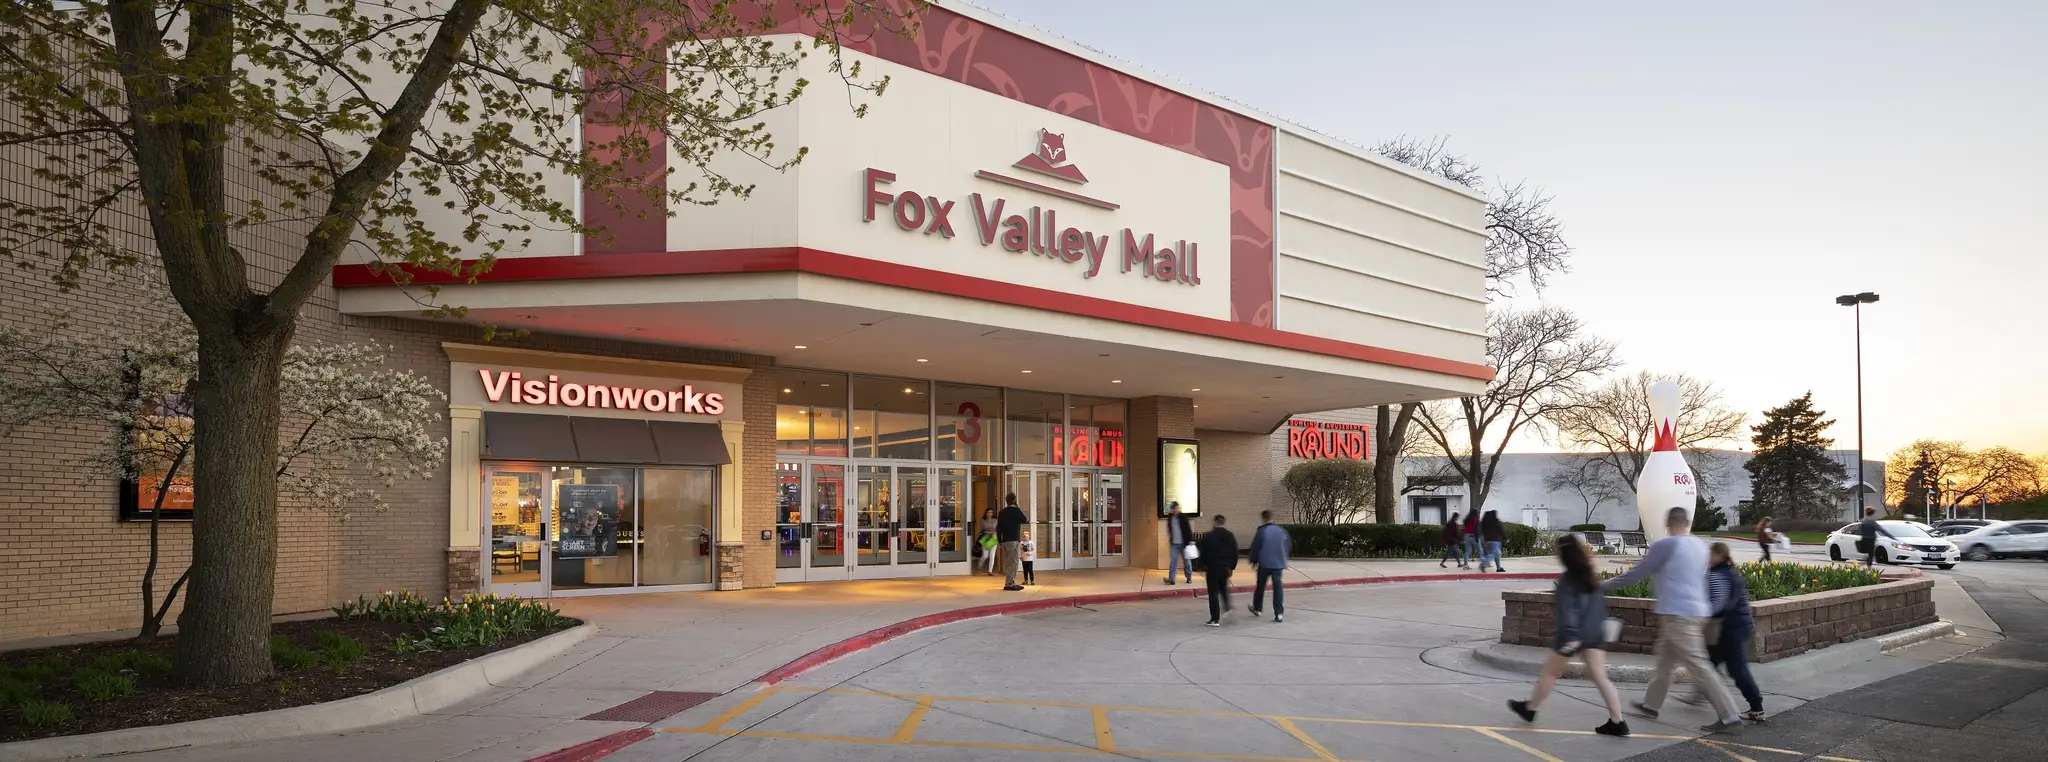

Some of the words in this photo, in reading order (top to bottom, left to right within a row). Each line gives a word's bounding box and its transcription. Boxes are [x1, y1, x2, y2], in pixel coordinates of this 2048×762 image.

[862, 167, 955, 238] Fox
[968, 192, 1109, 279] Valley
[1120, 228, 1200, 286] Mall
[477, 369, 725, 415] Visionworks
[957, 401, 982, 445] 3
[1054, 426, 1089, 435] BLIN
[1288, 419, 1318, 428] BOWLING
[1325, 422, 1363, 431] AMUSEMENT
[1288, 425, 1370, 460] ROUND1
